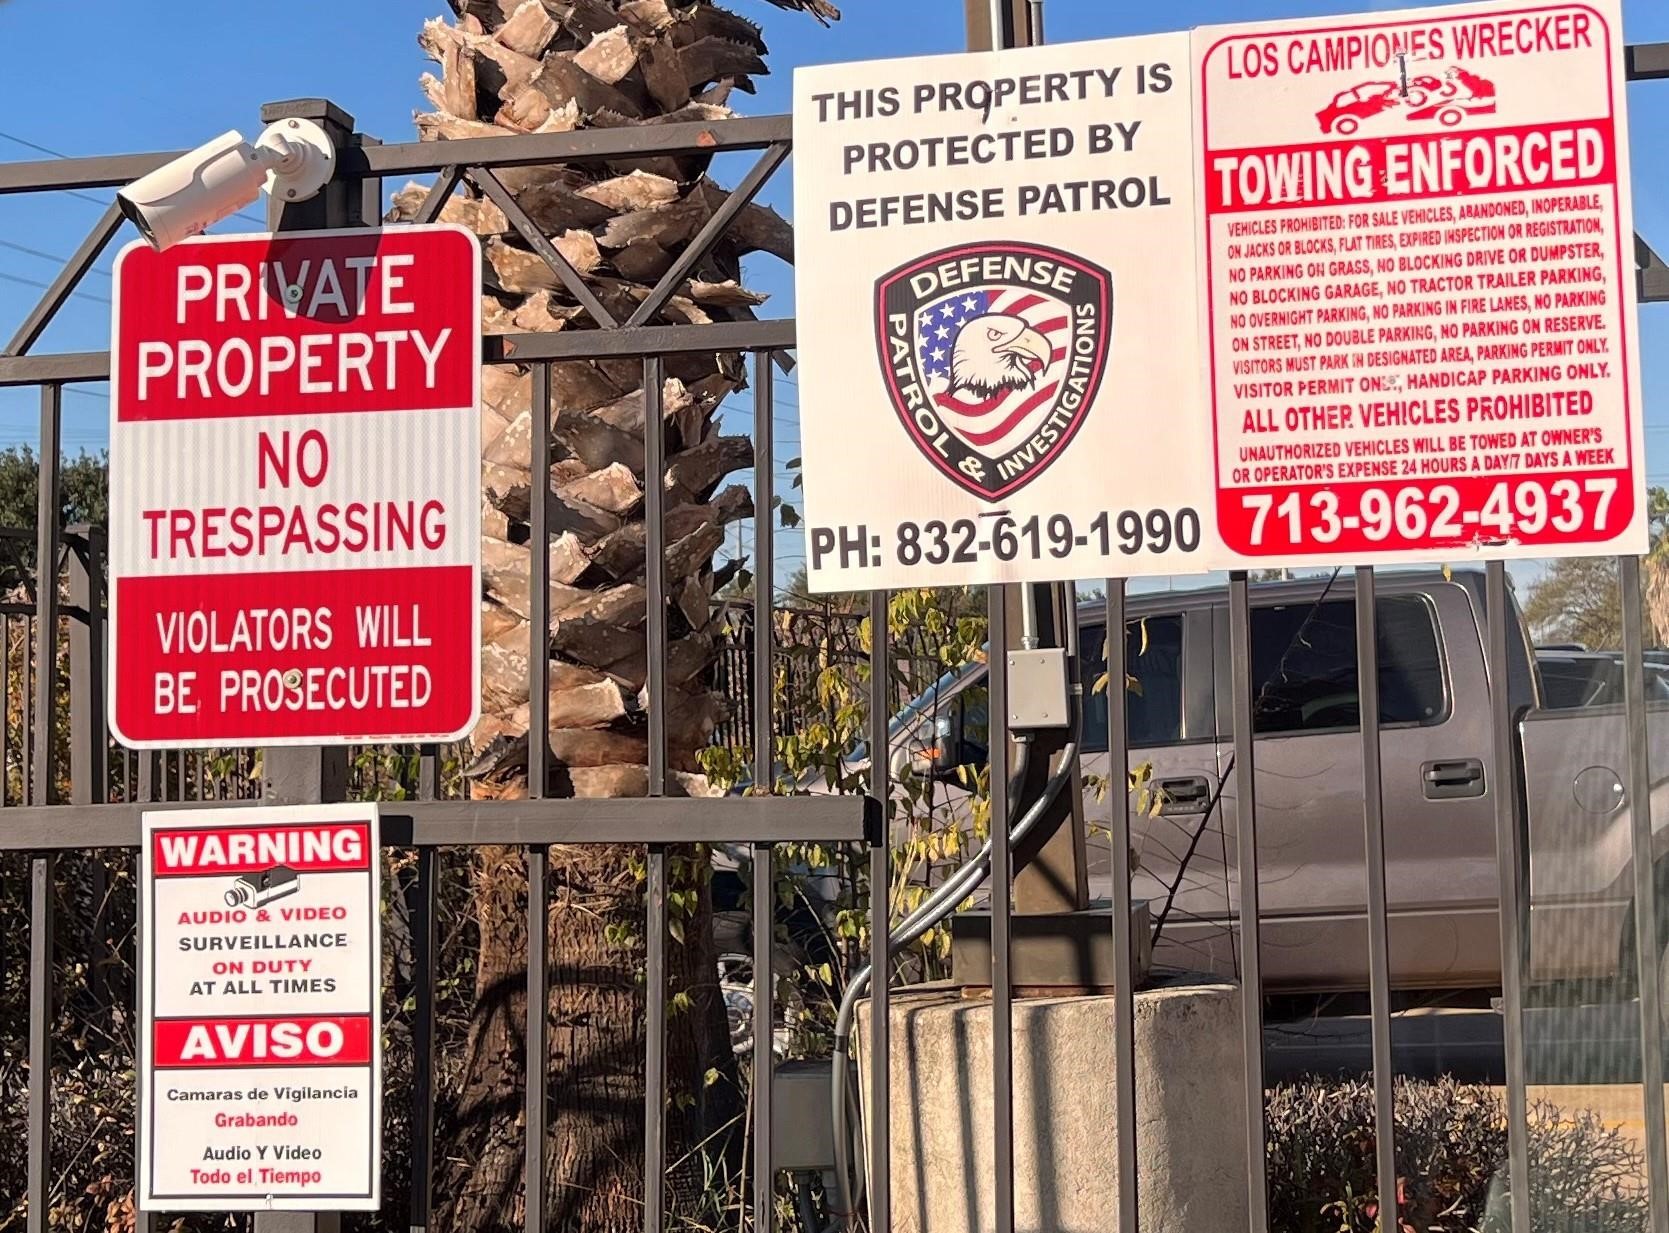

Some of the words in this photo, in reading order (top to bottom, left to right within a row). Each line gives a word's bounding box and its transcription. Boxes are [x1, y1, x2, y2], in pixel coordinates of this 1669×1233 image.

[1228, 42, 1278, 79] LOS
[1288, 28, 1444, 74] CAMPIONES
[1453, 14, 1591, 59] WRECKER
[812, 87, 899, 122] THIS
[914, 67, 1120, 113] PROPERTY
[1137, 63, 1172, 94] IS
[844, 127, 1074, 175] PROTECTED
[1089, 122, 1139, 154] BY
[1214, 146, 1371, 205] TOWING
[1386, 128, 1603, 195] ENFORCED
[830, 188, 1004, 231] DEFENSE
[1019, 176, 1170, 216] PATROL
[1228, 219, 1277, 237] VEHICLES
[1280, 215, 1345, 232] PROHIBITED:
[1349, 213, 1369, 228] FOR
[1372, 211, 1398, 227] SALE
[1402, 207, 1455, 224] VEHICLES,
[1459, 200, 1528, 220] ABANDONED,
[1532, 194, 1602, 213] INOPERABLE,
[1228, 245, 1241, 260] ON
[1244, 242, 1275, 258] JACKS
[1278, 241, 1291, 255] OR
[1295, 238, 1336, 255] BLOCKS,
[1339, 236, 1362, 251] FLAT
[1366, 233, 1396, 249] TIRES,
[1400, 230, 1441, 248] EXPIRED
[1445, 225, 1505, 244] INSPECTION
[1508, 223, 1522, 239] OR
[1526, 218, 1603, 237] REGISTRATION,
[909, 255, 1077, 299] DEFENSE
[1229, 267, 1245, 282] NO
[1250, 264, 1303, 281] PARKING
[1307, 263, 1324, 278] ON
[1329, 259, 1373, 276] GRASS,
[1378, 258, 1394, 272] NO
[1399, 253, 1462, 271] BLOCKING
[1467, 249, 1504, 266] DRIVE
[1509, 248, 1526, 263] OR
[1531, 242, 1604, 262] DUMPSTER,
[177, 254, 415, 323] PRIVATE
[1230, 290, 1247, 305] NO
[1253, 286, 1320, 305] BLOCKING
[1325, 282, 1382, 299] GARAGE,
[1388, 280, 1406, 295] NO
[1410, 275, 1473, 293] TRACTOR
[1477, 271, 1536, 289] TRAILER
[1541, 266, 1605, 285] PARKING,
[1231, 314, 1245, 328] NO
[1250, 309, 1313, 328] OVERNIGHT
[1317, 306, 1369, 323] PARKING,
[1373, 304, 1388, 319] NO
[1393, 301, 1441, 318] PARKING
[1446, 300, 1457, 314] IN
[1461, 298, 1486, 313] FIRE
[1490, 295, 1531, 312] LANES,
[1535, 294, 1551, 309] NO
[1555, 289, 1605, 308] PARKING
[1233, 337, 1249, 352] ON
[1253, 334, 1300, 351] STREET,
[1305, 332, 1321, 348] NO
[1326, 329, 1374, 347] DOUBLE
[1379, 325, 1436, 343] PARKING,
[1441, 323, 1458, 339] NO
[1463, 320, 1518, 338] PARKING
[1523, 318, 1540, 334] ON
[1545, 315, 1605, 333] RESERVE.
[138, 328, 452, 400] PROPERTY
[1234, 358, 1282, 375] VISITORS
[1286, 356, 1316, 372] MUST
[1320, 354, 1348, 369] PARK
[1352, 352, 1364, 368] IN
[1368, 348, 1436, 367] DESIGNATED
[1441, 347, 1473, 363] AREA,
[1477, 343, 1527, 360] PARKING
[1531, 339, 1573, 357] PERMIT
[1577, 338, 1608, 354] ONLY.
[888, 313, 952, 459] PATROL
[957, 455, 985, 483] &
[996, 302, 1095, 481] INVESTIGATIONS
[1234, 381, 1293, 399] VISITOR
[1298, 378, 1354, 395] PERMIT
[1408, 370, 1486, 389] HANDICAP
[1492, 365, 1561, 384] PARKING
[1567, 362, 1610, 379] ONLY.
[1243, 408, 1279, 433] ALL
[1285, 404, 1353, 431] OTHER
[1359, 398, 1459, 427] VEHICLES
[1467, 390, 1592, 421] PROHIBITED
[258, 429, 328, 489] NO
[1240, 442, 1340, 462] UNAUTHORIZED
[1346, 439, 1409, 456] VEHICLES
[1413, 437, 1445, 453] WILL
[1449, 436, 1466, 452] BE
[1470, 432, 1516, 449] TOWED
[1521, 431, 1537, 447] AT
[1542, 427, 1602, 446] OWNER'S
[1233, 468, 1250, 484] OR
[1255, 464, 1333, 483] OPERATOR'S
[1338, 460, 1397, 478] EXPENSE
[1402, 459, 1417, 475] 24
[1421, 457, 1467, 474] HOURS
[1472, 456, 1480, 471] A
[1485, 454, 1520, 470] DAY/7
[1525, 451, 1558, 468] DAYS
[1563, 450, 1572, 466] A
[1575, 448, 1614, 465] WEEK
[143, 500, 446, 559] TRESPASSING
[1243, 478, 1616, 544] 713-962-4937
[811, 525, 881, 570] PH:
[897, 508, 1200, 566] 832-619-1990
[157, 607, 332, 653] VIOLATORS
[356, 605, 431, 647] WILL
[155, 672, 196, 714] BE
[221, 665, 431, 711] PROSECUTED
[159, 828, 362, 868] WARNING
[178, 909, 247, 925] AUDIO
[256, 909, 270, 922] &
[281, 906, 347, 922] VIDEO
[178, 933, 348, 952] SURVEILLANCE
[189, 981, 217, 996] AT
[223, 980, 263, 995] ALL
[270, 978, 336, 994] TIMES
[212, 961, 244, 975] ON
[252, 959, 313, 974] DUTY
[179, 1021, 344, 1060] AVISO
[167, 1088, 243, 1101] Camaras
[247, 1087, 269, 1100] de
[274, 1086, 358, 1102] Vigilancia
[215, 1111, 298, 1128] Grabando
[203, 1145, 251, 1161] Audio
[256, 1145, 269, 1160] Y
[273, 1145, 322, 1160] Video
[190, 1168, 231, 1184] Todo
[236, 1168, 252, 1184] el
[259, 1168, 322, 1187] Tiempo
